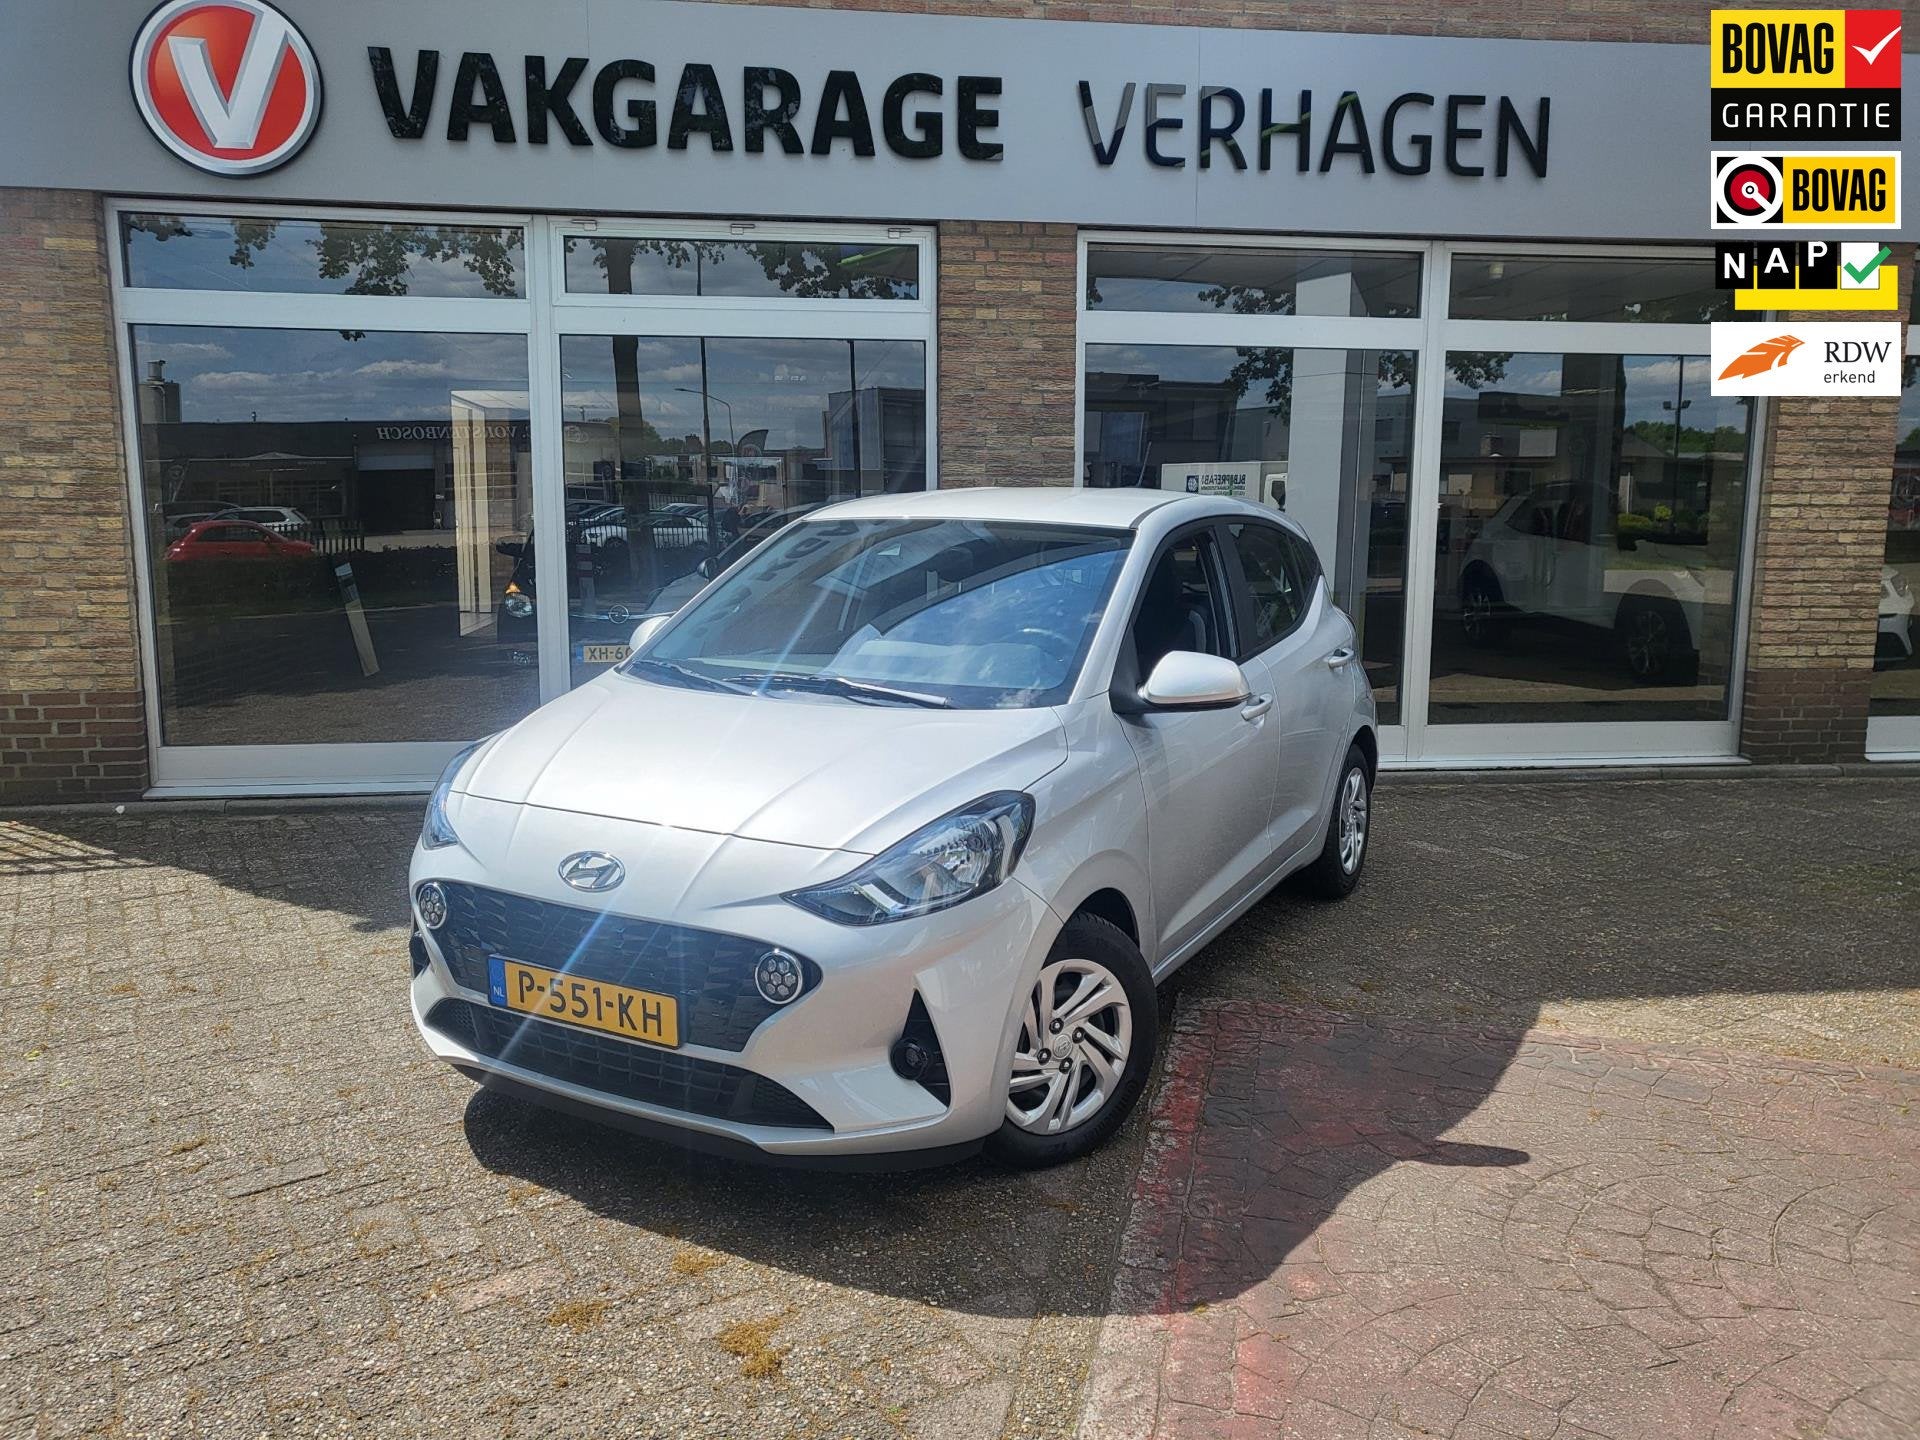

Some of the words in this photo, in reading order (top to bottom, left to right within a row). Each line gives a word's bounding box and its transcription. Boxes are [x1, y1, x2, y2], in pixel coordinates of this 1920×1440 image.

[366, 46, 1004, 161] VAKGARAGE
[1077, 79, 1551, 178] VERHAGEN
[493, 985, 505, 998] NL
[518, 970, 662, 1037] P-551-KH
